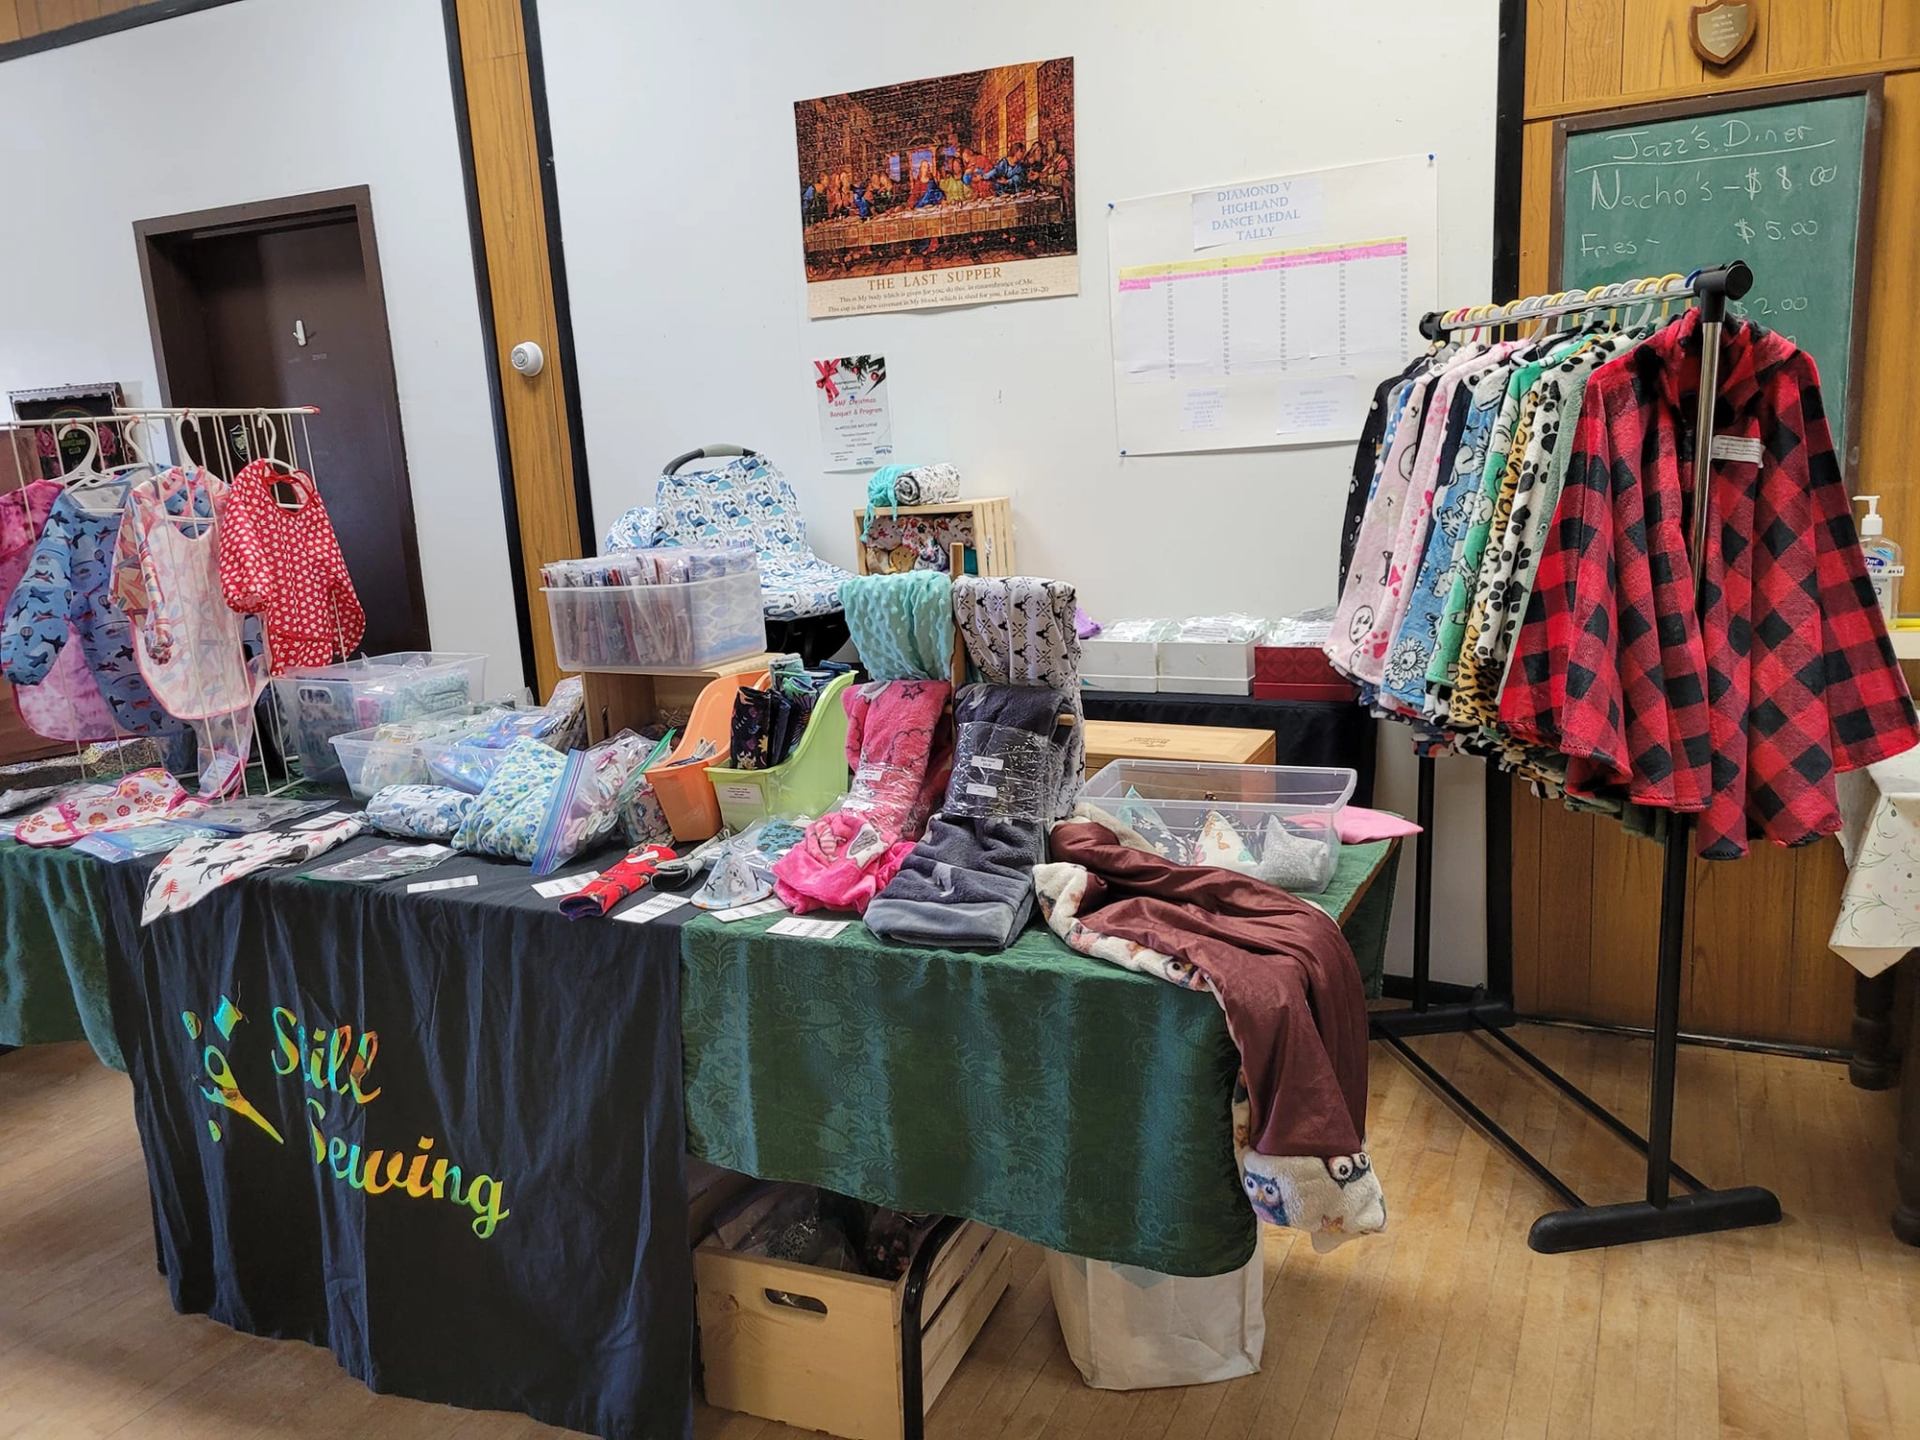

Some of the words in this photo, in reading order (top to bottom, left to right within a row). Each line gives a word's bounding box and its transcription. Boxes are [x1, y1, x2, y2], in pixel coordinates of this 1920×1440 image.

[1605, 124, 1711, 160] Jazz's
[1720, 119, 1814, 147] Diner
[1216, 183, 1280, 202] DIAMOND
[1283, 181, 1292, 191] V
[1591, 169, 1713, 210] Nacho's
[1221, 196, 1289, 216] HIGHLAND
[1211, 215, 1254, 231] DANCE
[1257, 209, 1301, 224] MEDAL
[1236, 226, 1275, 241] TALLY
[867, 279, 895, 291] THE
[903, 273, 938, 288] LAST
[947, 266, 1002, 283] SUPPER
[858, 295, 867, 303] My
[883, 291, 900, 299] which
[828, 305, 839, 313] This
